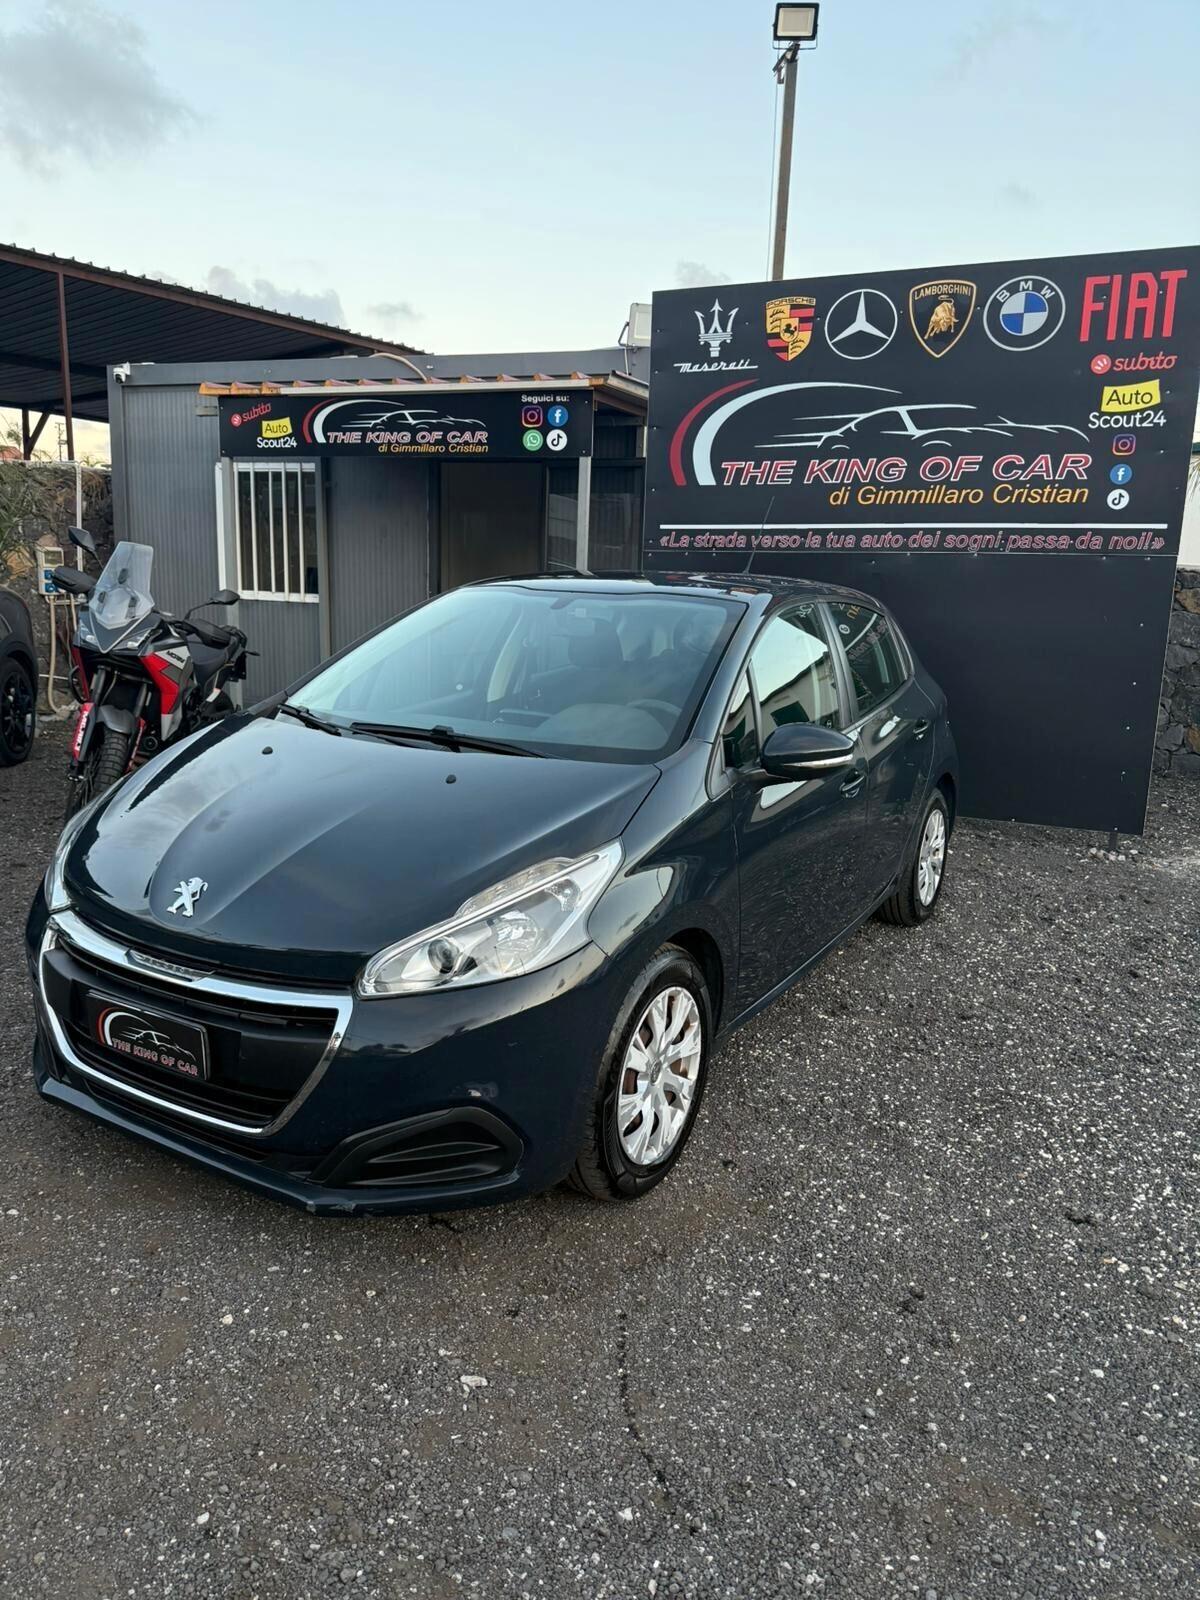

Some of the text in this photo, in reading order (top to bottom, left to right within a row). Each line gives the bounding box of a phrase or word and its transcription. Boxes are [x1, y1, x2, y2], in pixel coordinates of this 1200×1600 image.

[914, 284, 971, 300] LAMBORGHINI
[996, 280, 1056, 303] BMW
[766, 297, 815, 307] PORSCHE
[1080, 270, 1188, 342] FIAT
[1113, 351, 1178, 371] subito
[521, 394, 553, 404] Seguici
[1106, 389, 1153, 406] Auto
[242, 403, 271, 421] subito
[1088, 410, 1167, 429] Scout24
[264, 423, 289, 433] Auto
[327, 431, 488, 443] THE KING OF CAR
[256, 436, 298, 448] Scout24
[378, 443, 489, 453] di Gimmillaro Cristian
[721, 453, 1093, 486] THE KING OF CAR
[829, 483, 1089, 505] di Gimmillaro Cristian
[693, 531, 747, 548] strada
[751, 533, 800, 548] verso
[805, 531, 820, 548] la
[826, 532, 856, 548] tua
[860, 531, 903, 548] auto
[908, 530, 941, 548] dei
[943, 530, 1003, 552] sogni
[1005, 533, 1071, 552] passa
[1075, 531, 1104, 549] da
[112, 1037, 198, 1077] THE KING OF CAR
